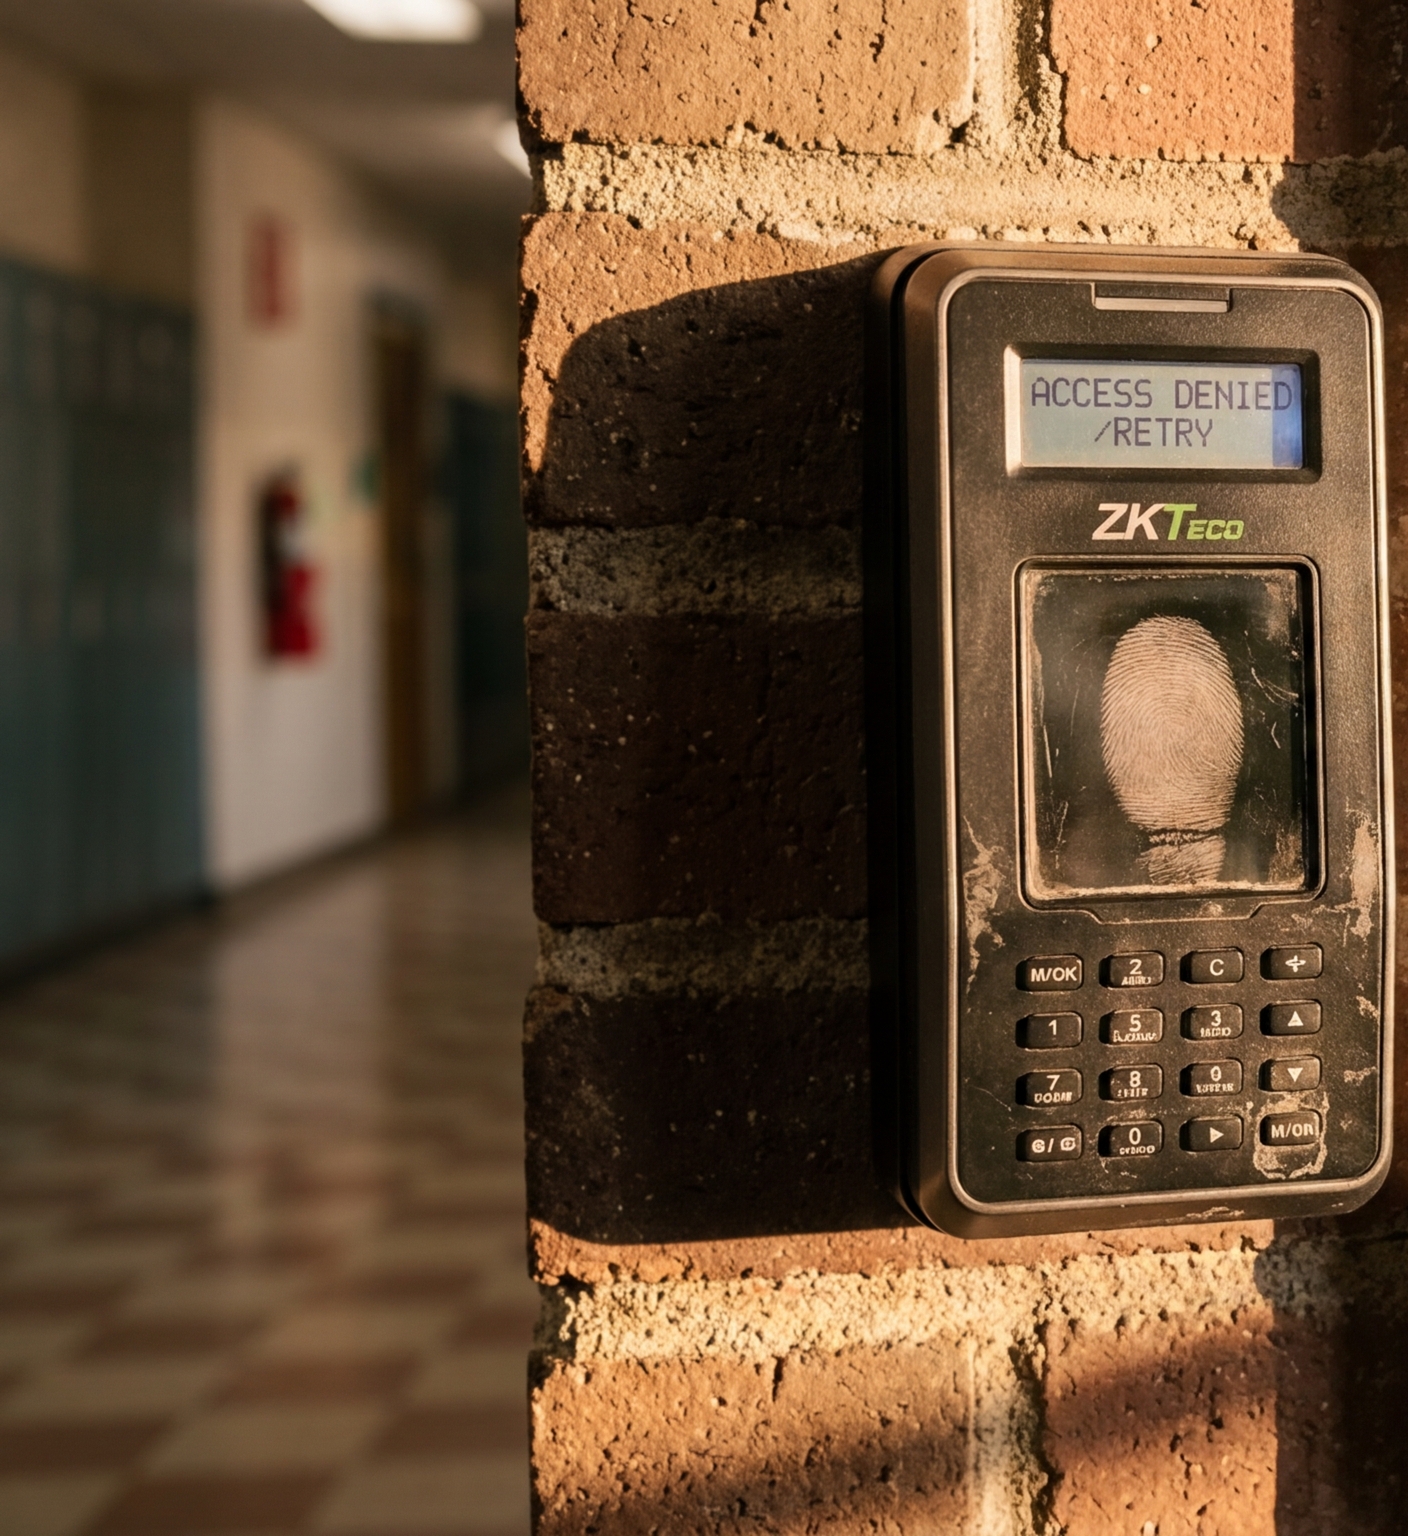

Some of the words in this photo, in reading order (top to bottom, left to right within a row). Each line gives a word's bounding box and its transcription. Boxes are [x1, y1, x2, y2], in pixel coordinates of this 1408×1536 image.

[1031, 376, 1152, 409] ACCESS
[1175, 379, 1293, 411] DENIED
[1094, 417, 1213, 447] /RETRY
[1030, 966, 1078, 982] M/OK
[1129, 958, 1142, 976] 2
[1209, 958, 1225, 976] C
[1048, 1019, 1057, 1036] 1
[1129, 1014, 1142, 1032] 5
[1210, 1010, 1222, 1027] 3
[1046, 1074, 1061, 1091] 7
[1129, 1070, 1141, 1088] 8
[1128, 1127, 1142, 1145] 0
